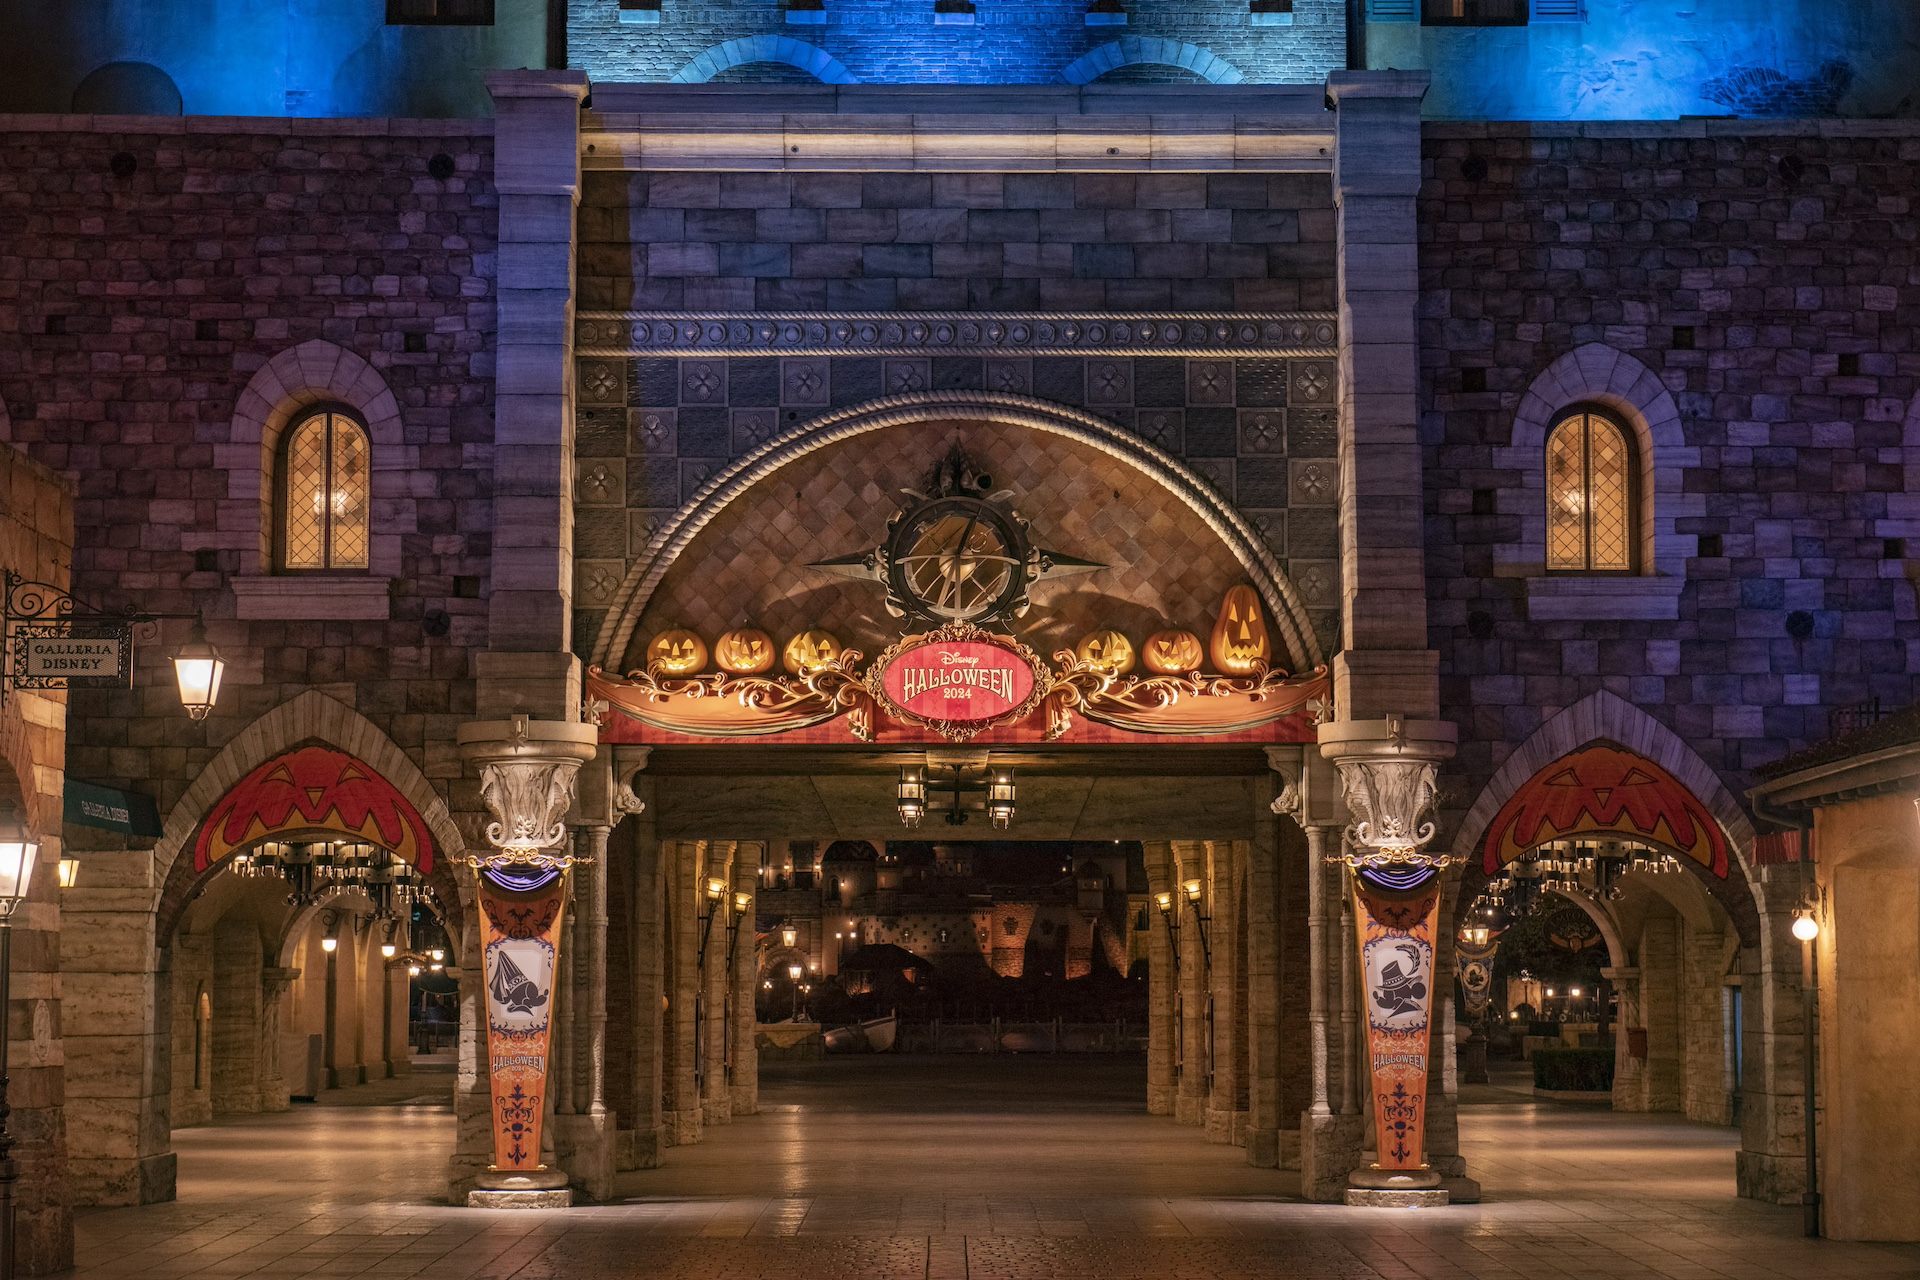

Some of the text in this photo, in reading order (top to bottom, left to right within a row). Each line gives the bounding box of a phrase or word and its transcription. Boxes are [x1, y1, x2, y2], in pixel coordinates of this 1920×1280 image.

[34, 644, 113, 655] GALLERIA
[42, 658, 103, 670] DISNEY
[938, 651, 979, 668] Disney
[903, 667, 1014, 704] HALLOWEEN
[943, 687, 973, 699] 2024
[492, 1056, 545, 1074] HALLOWEEN
[1373, 1054, 1426, 1072] HALLOWEEN
